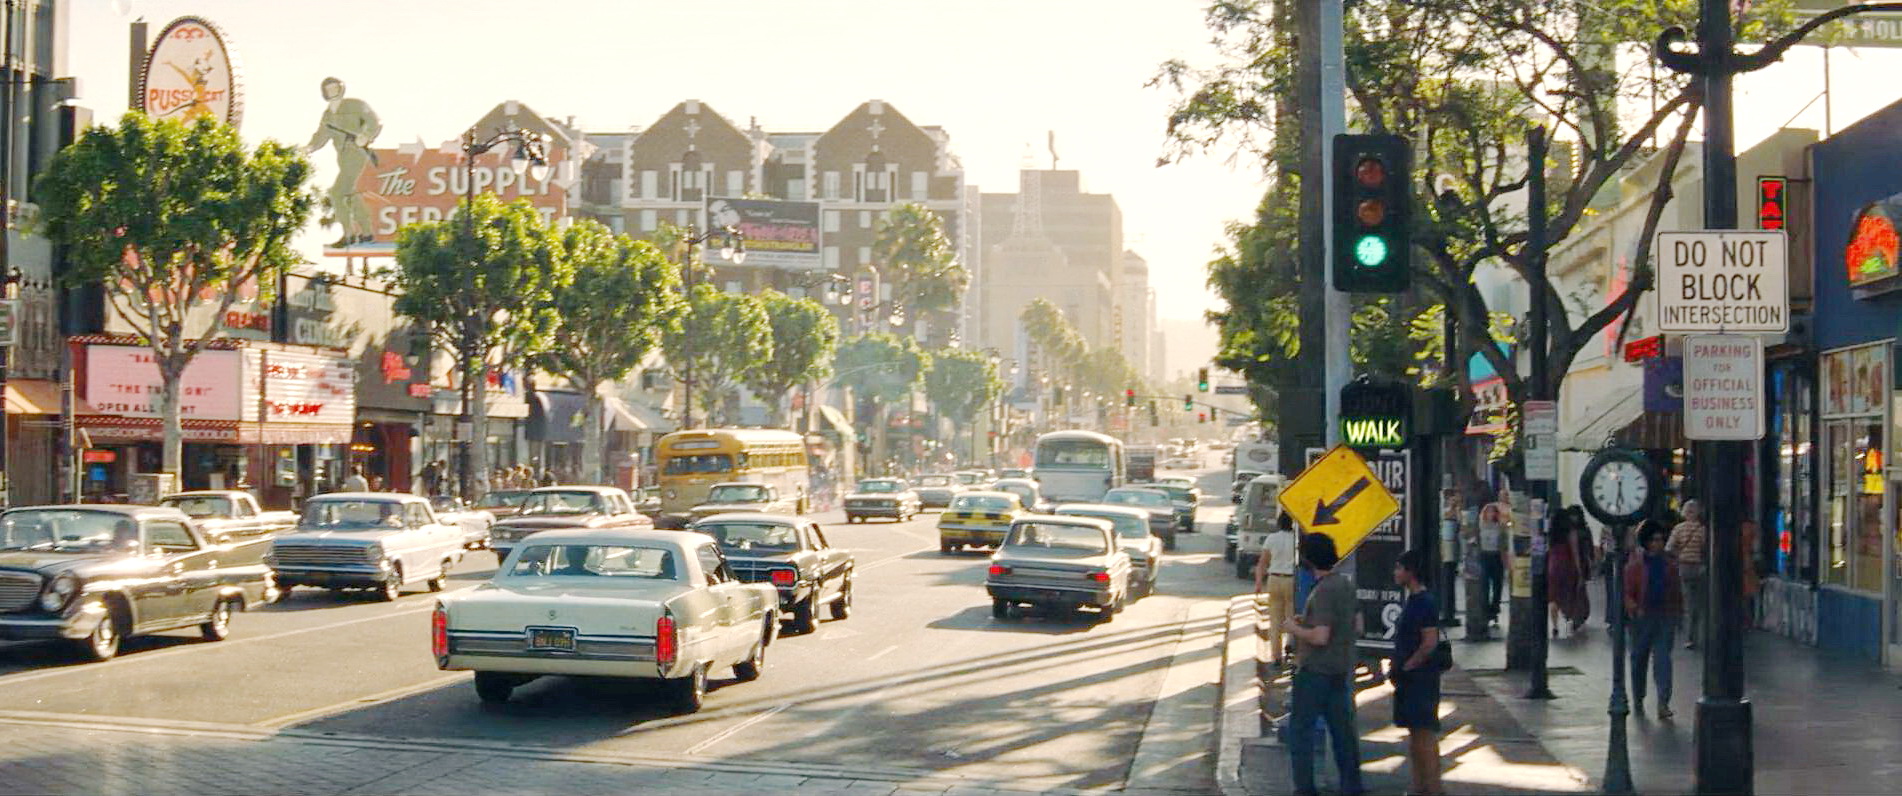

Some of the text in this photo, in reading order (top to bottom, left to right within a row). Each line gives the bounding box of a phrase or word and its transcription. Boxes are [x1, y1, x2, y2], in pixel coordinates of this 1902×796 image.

[378, 165, 557, 196] The SUPPLY
[1674, 240, 1768, 267] DO NOT
[1682, 273, 1761, 301] BLOCK
[1664, 305, 1781, 325] INTERSECTION
[1694, 345, 1752, 358] PARKING
[1713, 362, 1732, 372] FOR
[1693, 378, 1753, 391] OFFICIAL
[97, 403, 156, 413] OPEN ALL
[1691, 397, 1755, 410] BUSINESS
[1705, 415, 1741, 429] ONLY
[1346, 419, 1401, 443] WALK
[1381, 602, 1403, 640] 9
